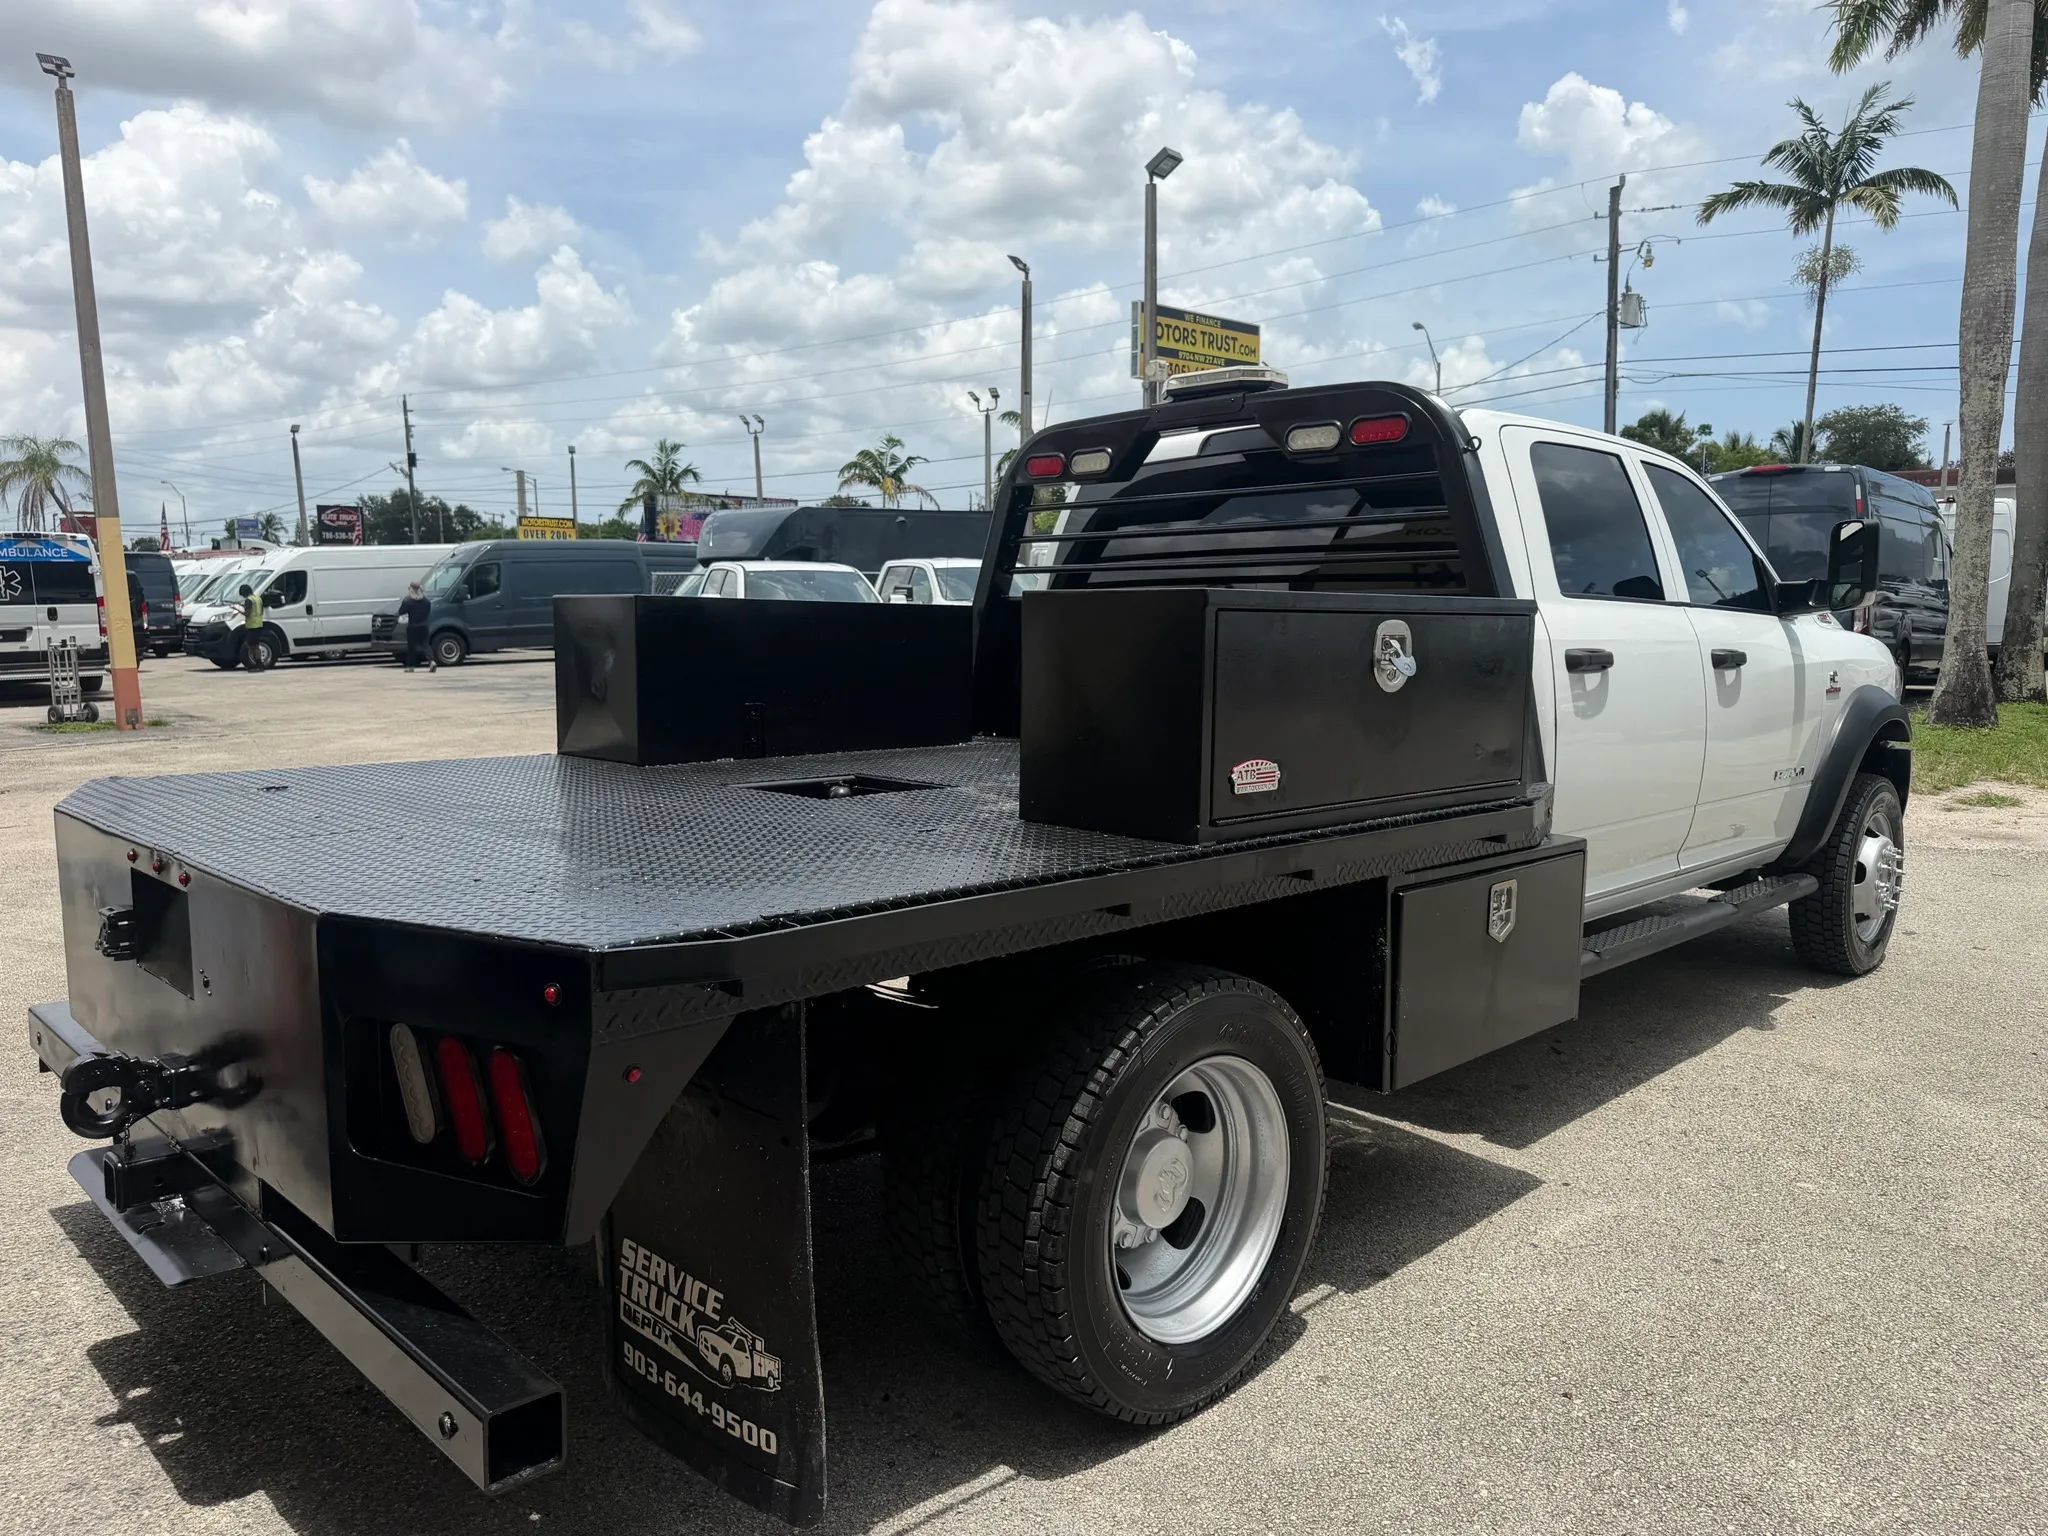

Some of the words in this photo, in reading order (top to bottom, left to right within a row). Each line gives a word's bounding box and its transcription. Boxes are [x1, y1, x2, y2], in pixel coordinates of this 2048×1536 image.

[1184, 313, 1195, 323] WE
[1196, 315, 1222, 328] FINANCE
[1157, 322, 1197, 346] OTORS
[1213, 356, 1225, 366] AVE
[523, 529, 547, 539] OVER
[0, 547, 68, 558] MBULANCE
[620, 1238, 724, 1321] SERVICE
[619, 1265, 696, 1340] TRUCK
[622, 1300, 673, 1347] DEPOT
[623, 1340, 777, 1455] 903-644-9500
